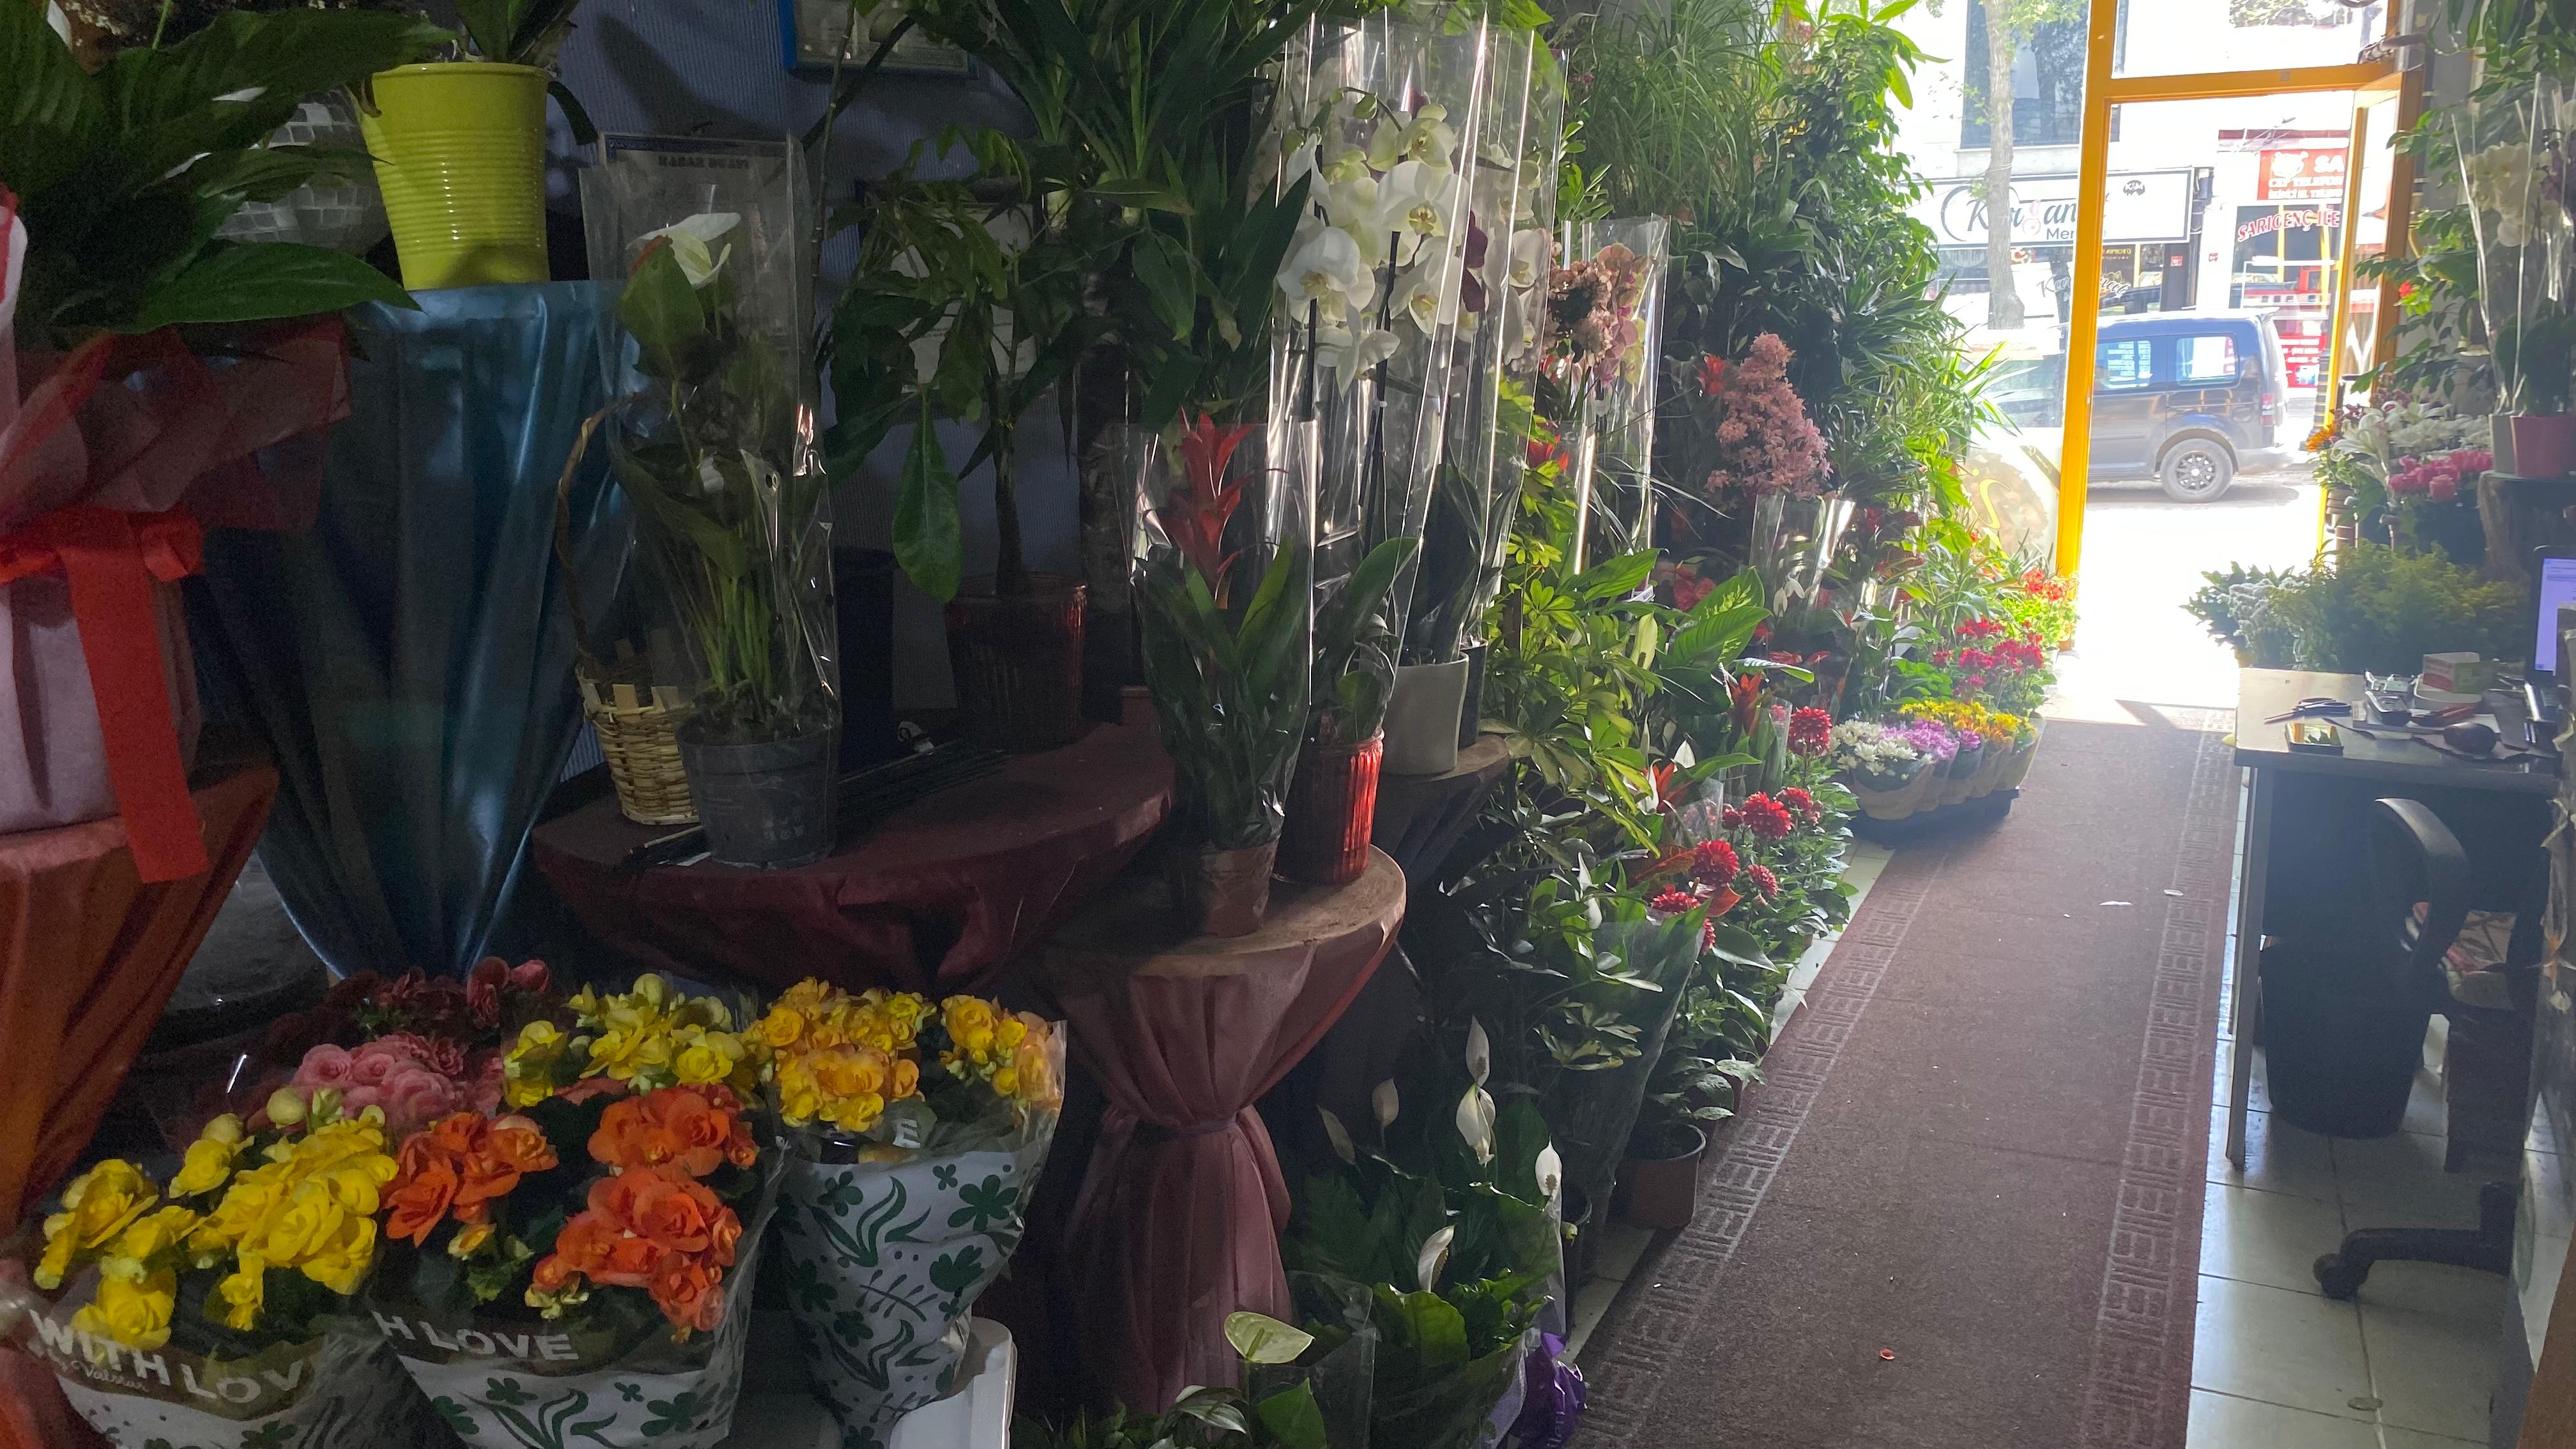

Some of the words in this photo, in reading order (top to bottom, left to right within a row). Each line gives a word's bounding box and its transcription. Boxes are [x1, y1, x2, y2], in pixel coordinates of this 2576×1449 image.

[29, 1308, 171, 1386] WITH
[181, 1360, 304, 1404] LOV
[418, 1321, 579, 1360] LOVE
